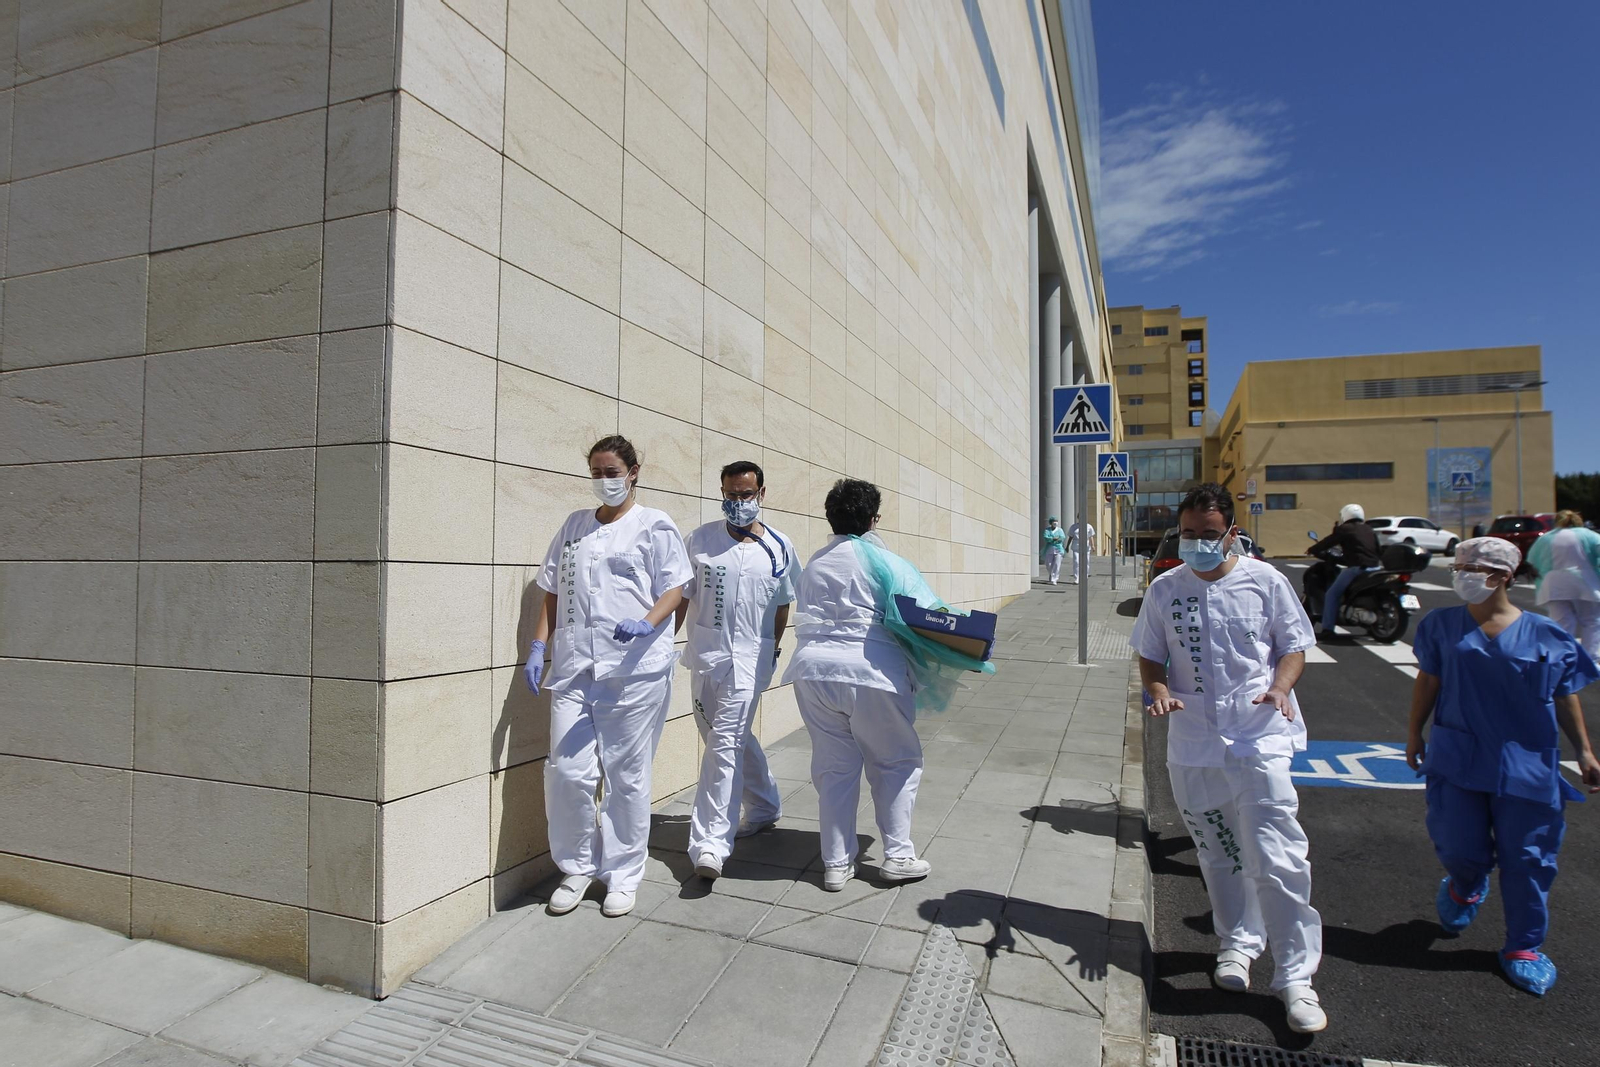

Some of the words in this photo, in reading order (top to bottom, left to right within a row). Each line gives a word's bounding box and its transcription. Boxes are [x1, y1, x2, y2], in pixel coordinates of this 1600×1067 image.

[561, 540, 572, 584] AREA
[567, 538, 581, 624] QUIRURGICA
[704, 564, 712, 589] AREA
[714, 565, 727, 627] QUIRURGICA
[925, 615, 945, 624] UNION
[1186, 596, 1204, 693] QUIRURGICA
[1203, 809, 1243, 875] QUIRURGIA
